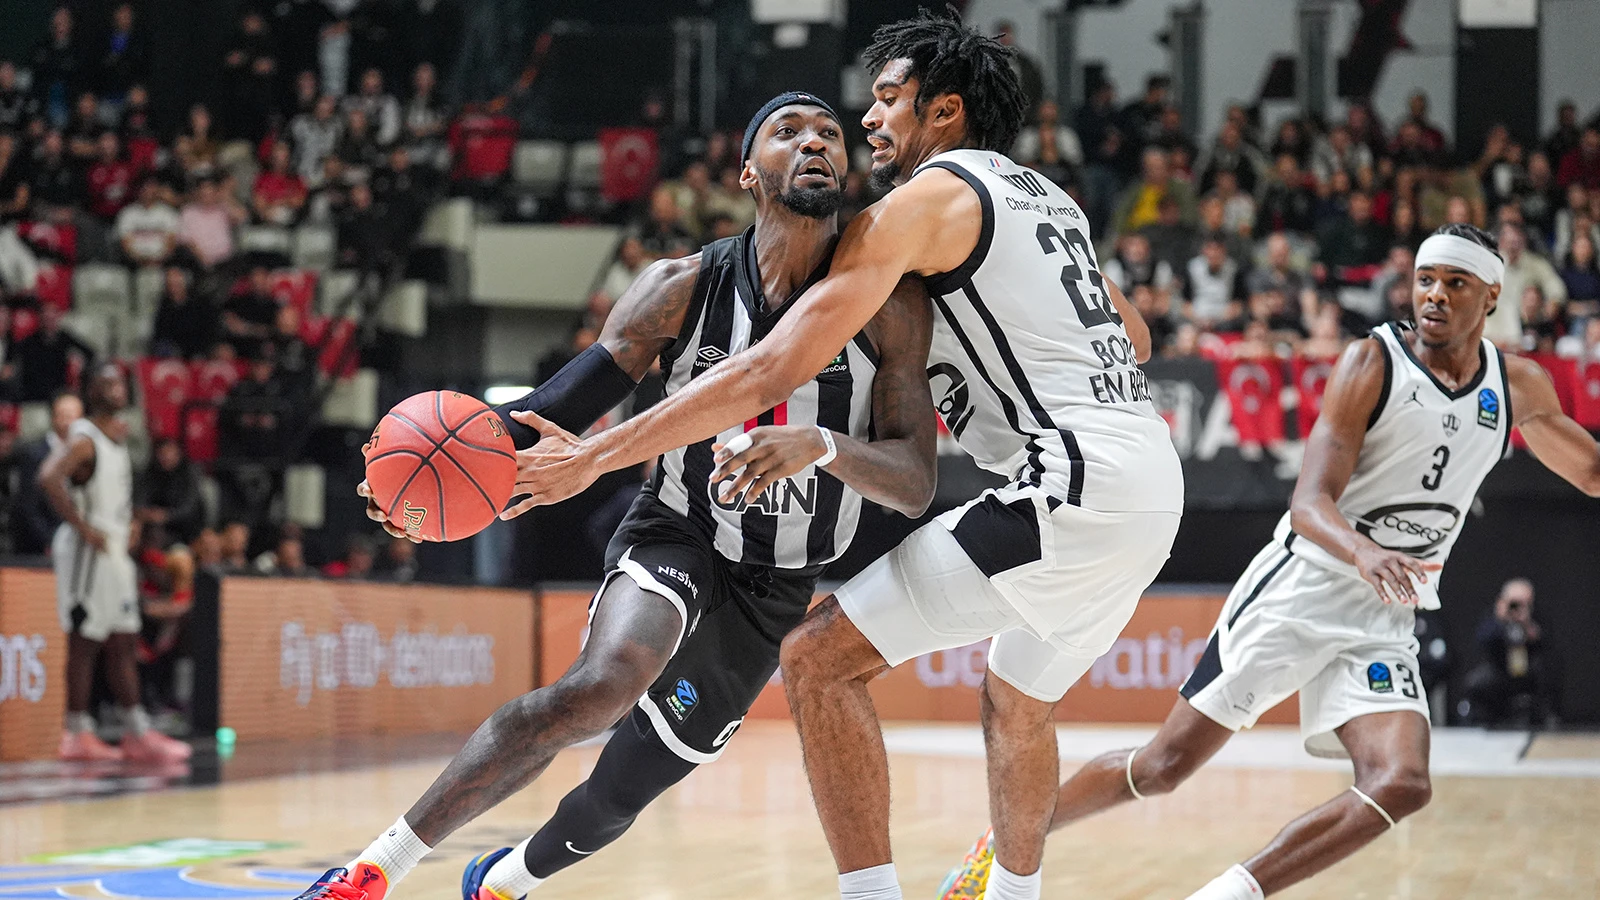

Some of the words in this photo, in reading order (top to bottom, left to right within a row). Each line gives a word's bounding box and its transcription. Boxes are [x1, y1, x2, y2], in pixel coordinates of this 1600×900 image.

[695, 360, 714, 368] umb
[1089, 371, 1127, 404] EN
[1421, 445, 1450, 491] 3
[1396, 663, 1419, 699] 3
